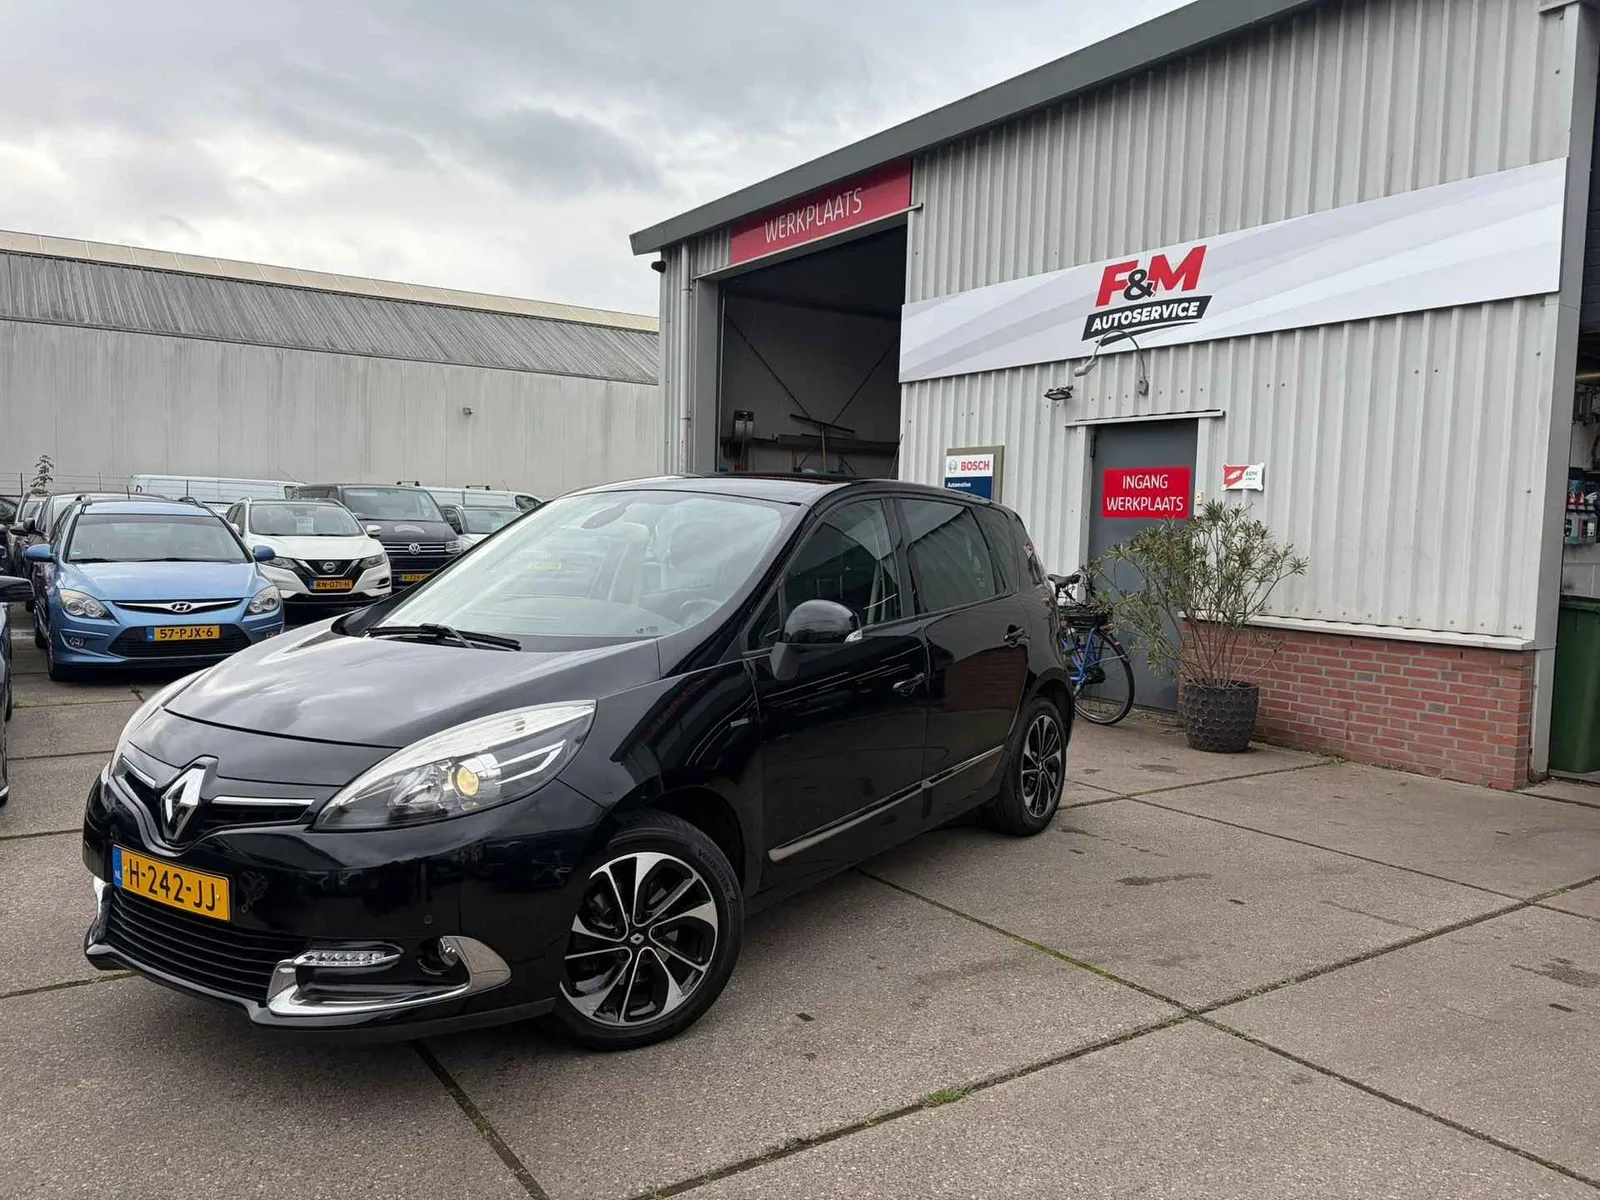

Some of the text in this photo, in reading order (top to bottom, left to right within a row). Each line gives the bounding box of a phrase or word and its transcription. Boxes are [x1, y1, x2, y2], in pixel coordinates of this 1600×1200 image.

[764, 187, 862, 244] WERKPLAATS
[1095, 244, 1207, 308] F&M
[1090, 301, 1200, 332] AUTOSERVICE
[960, 460, 990, 471] BOSCH
[1122, 474, 1169, 490] INGANG
[1106, 496, 1184, 512] WERKPLAATS
[160, 627, 213, 639] 57-PJX-6
[129, 858, 216, 911] H-242-JJ
